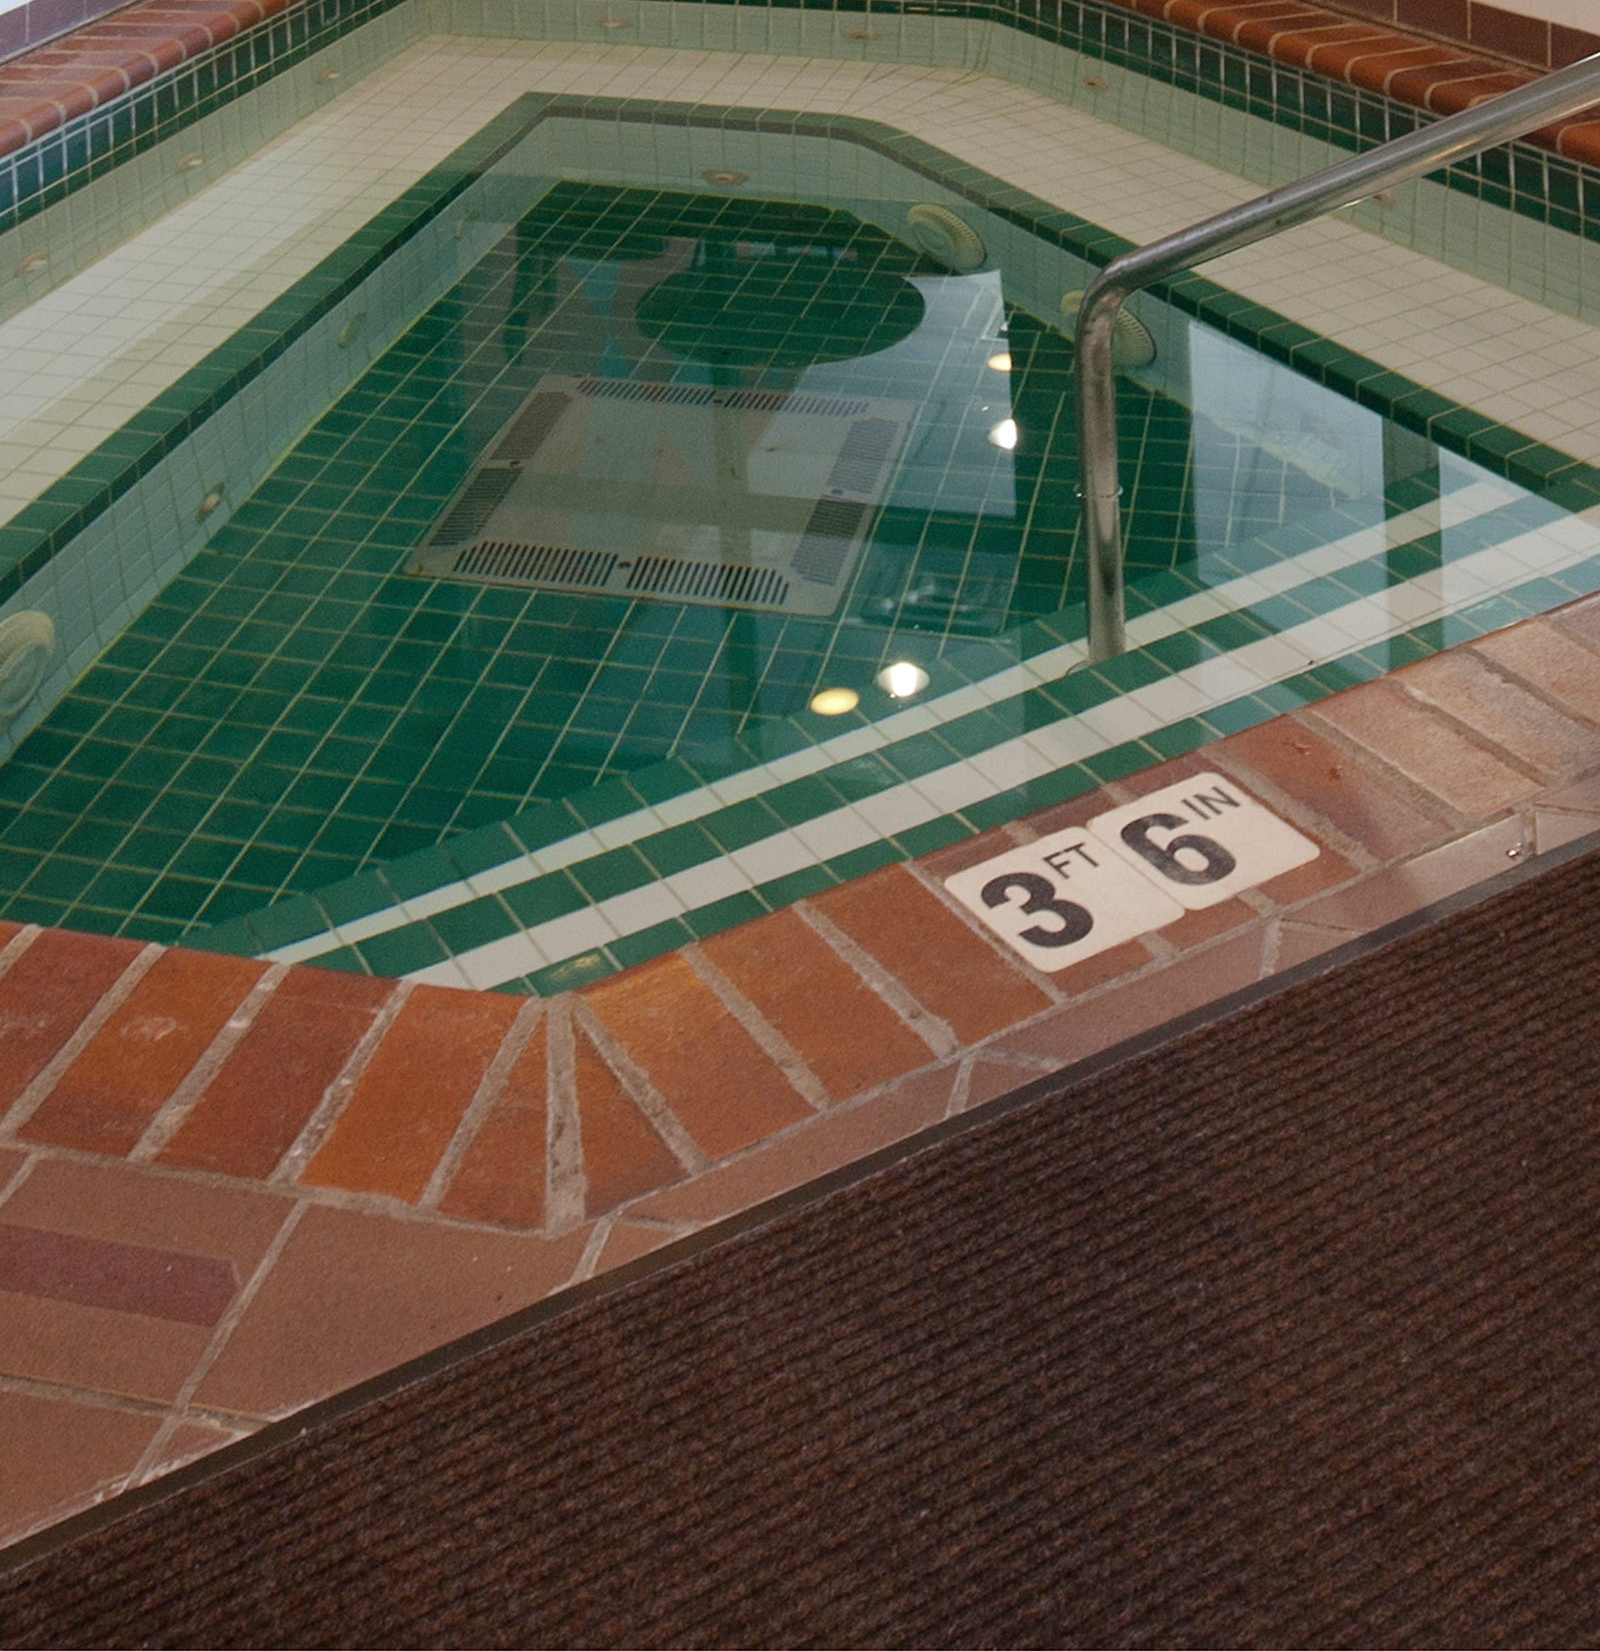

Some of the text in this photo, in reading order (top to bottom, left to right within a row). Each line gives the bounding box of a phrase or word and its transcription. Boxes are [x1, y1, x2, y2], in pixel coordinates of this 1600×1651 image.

[981, 786, 1241, 948] 3 FT 6 IN
